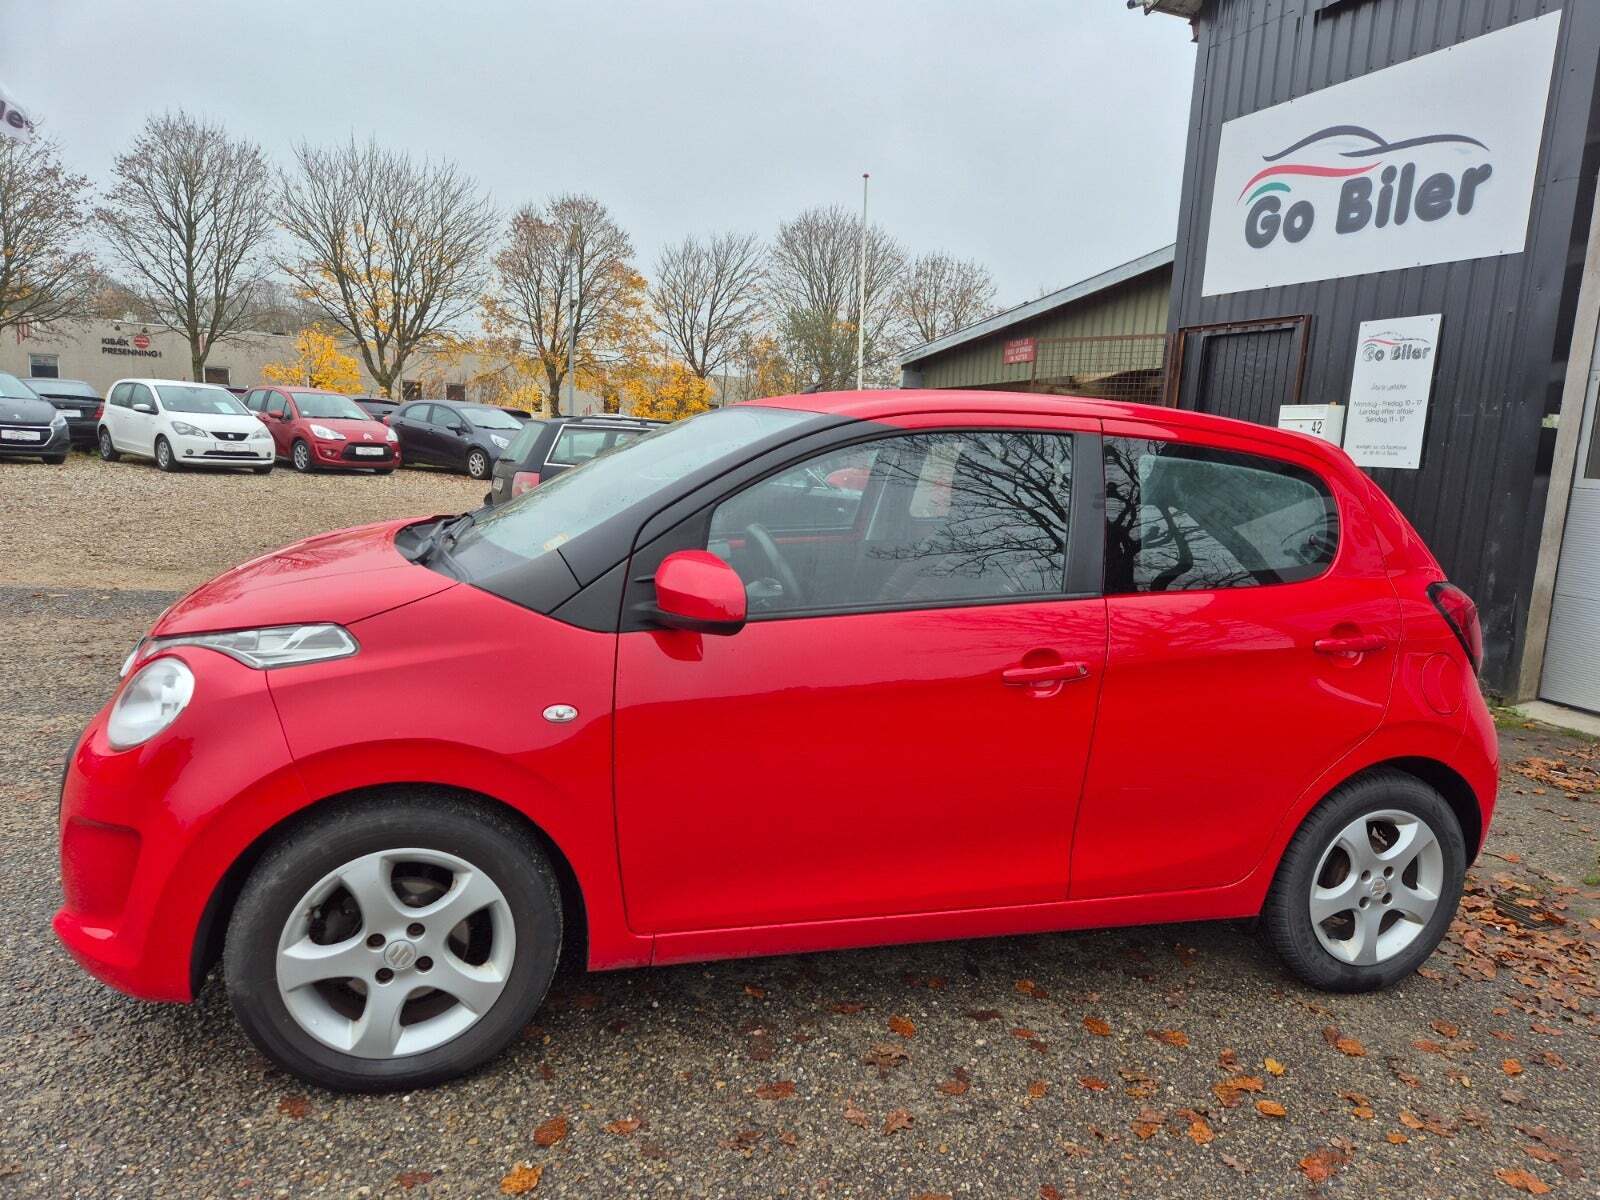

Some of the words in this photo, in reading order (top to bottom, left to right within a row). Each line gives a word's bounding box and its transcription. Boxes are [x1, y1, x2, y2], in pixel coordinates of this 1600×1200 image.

[1245, 195, 1315, 249] Go
[1336, 162, 1492, 234] Biler
[1390, 344, 1431, 360] Biler
[1312, 421, 1322, 433] 42
